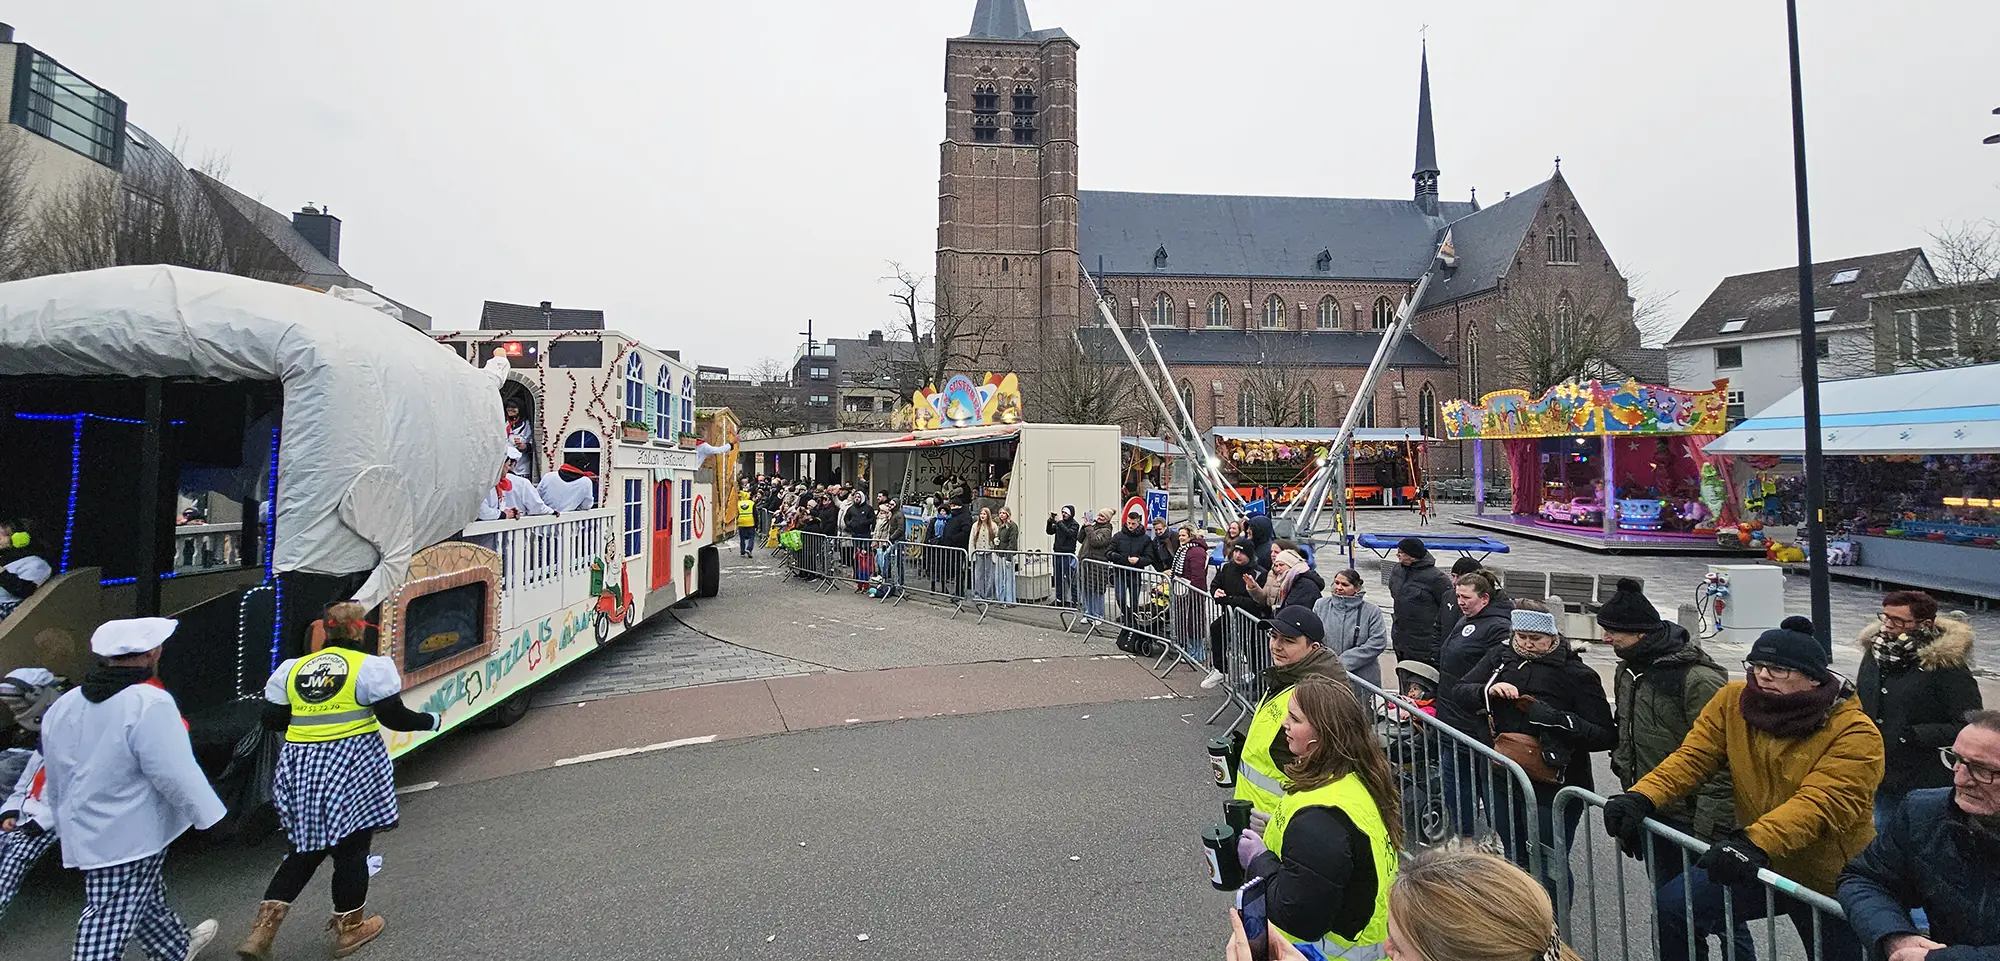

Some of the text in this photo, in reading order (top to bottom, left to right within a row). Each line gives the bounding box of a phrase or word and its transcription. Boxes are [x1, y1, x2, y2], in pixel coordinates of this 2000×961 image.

[920, 466, 978, 474] FRITUUR
[485, 628, 532, 691] PIZZA
[538, 617, 553, 643] IS
[301, 675, 335, 688] JWK
